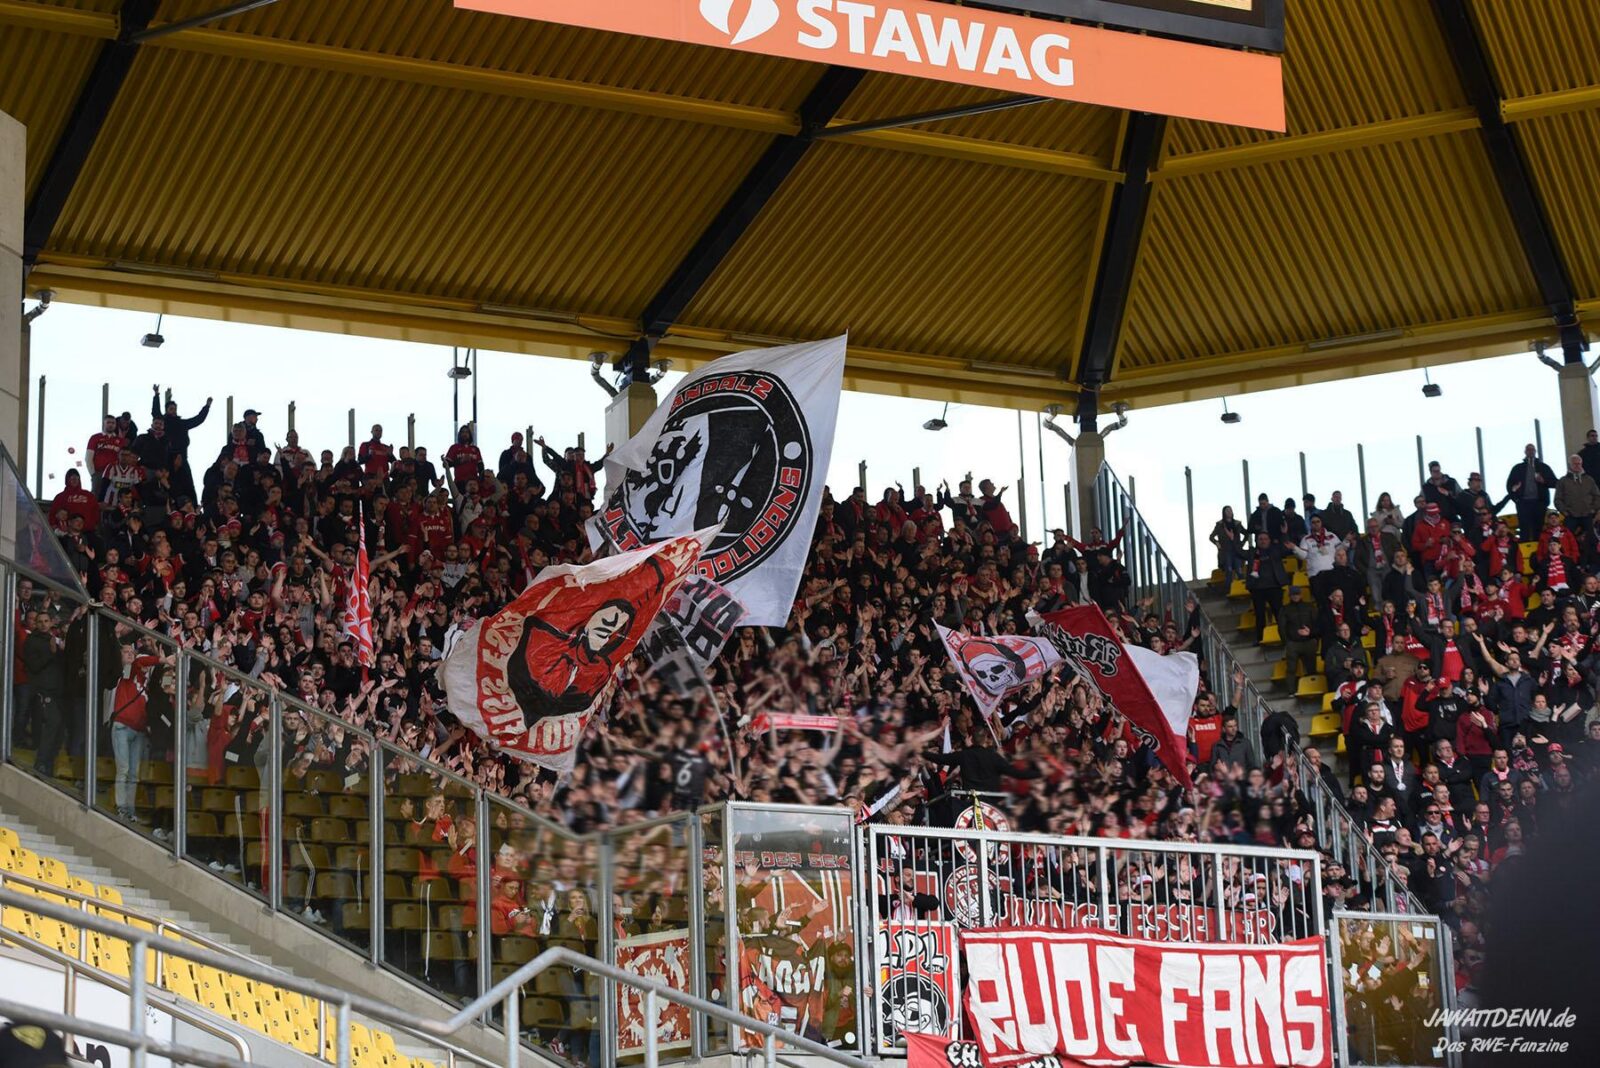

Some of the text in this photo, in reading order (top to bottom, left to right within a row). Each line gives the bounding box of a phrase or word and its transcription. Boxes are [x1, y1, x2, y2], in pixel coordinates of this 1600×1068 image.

[797, 0, 1074, 87] STAWAG
[965, 941, 1324, 1067] RUDE FANS
